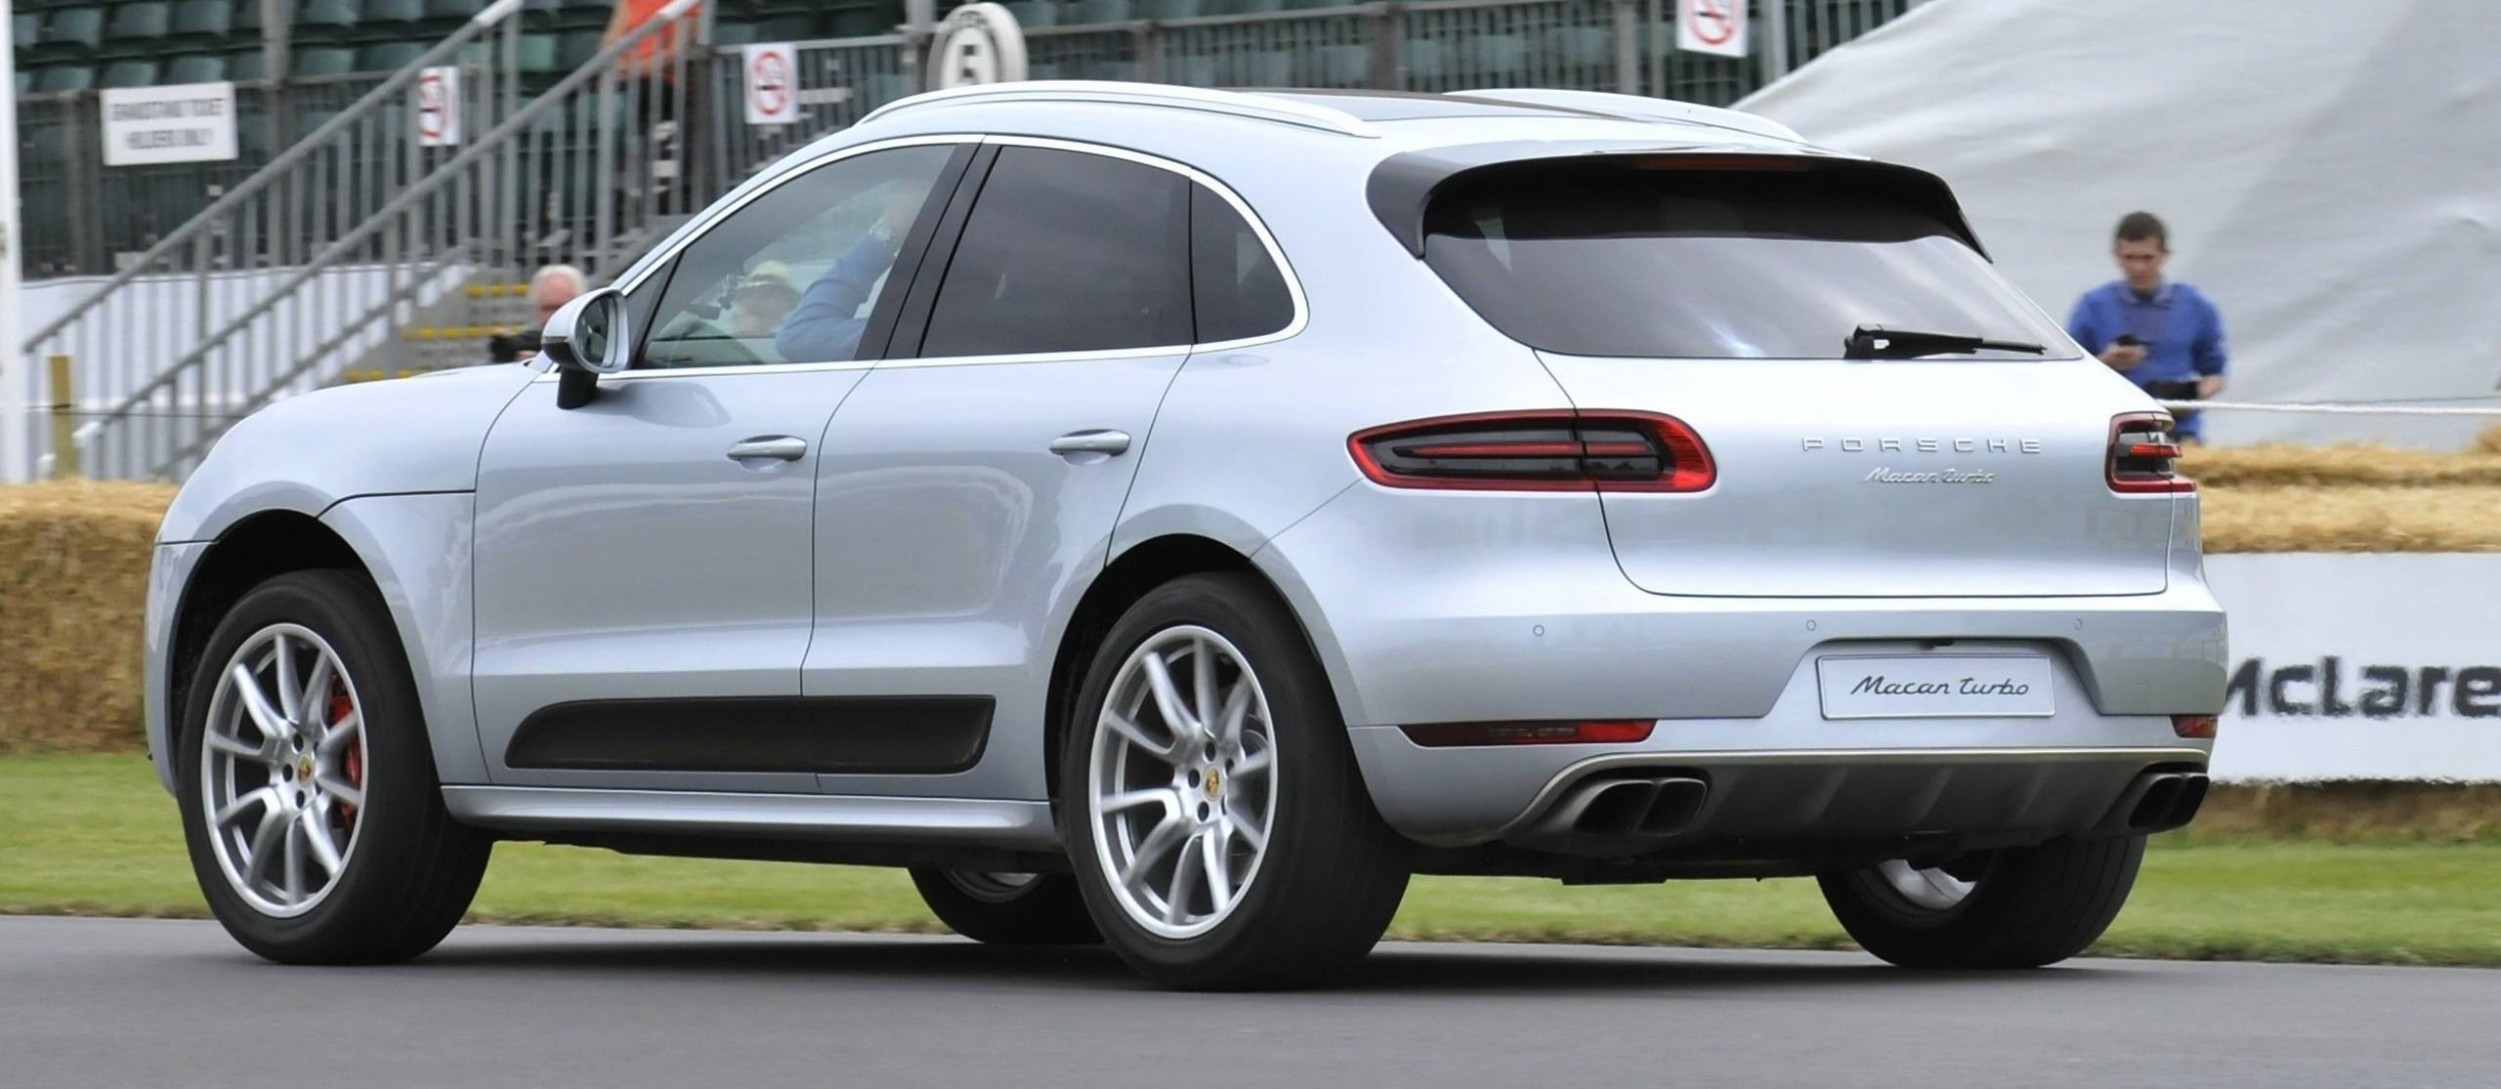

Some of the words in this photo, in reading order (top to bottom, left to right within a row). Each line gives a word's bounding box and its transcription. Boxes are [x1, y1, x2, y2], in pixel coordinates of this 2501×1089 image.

[1801, 437, 2042, 454] PORSCHE
[1862, 467, 1939, 484] Macan
[1850, 675, 1950, 696] Macan
